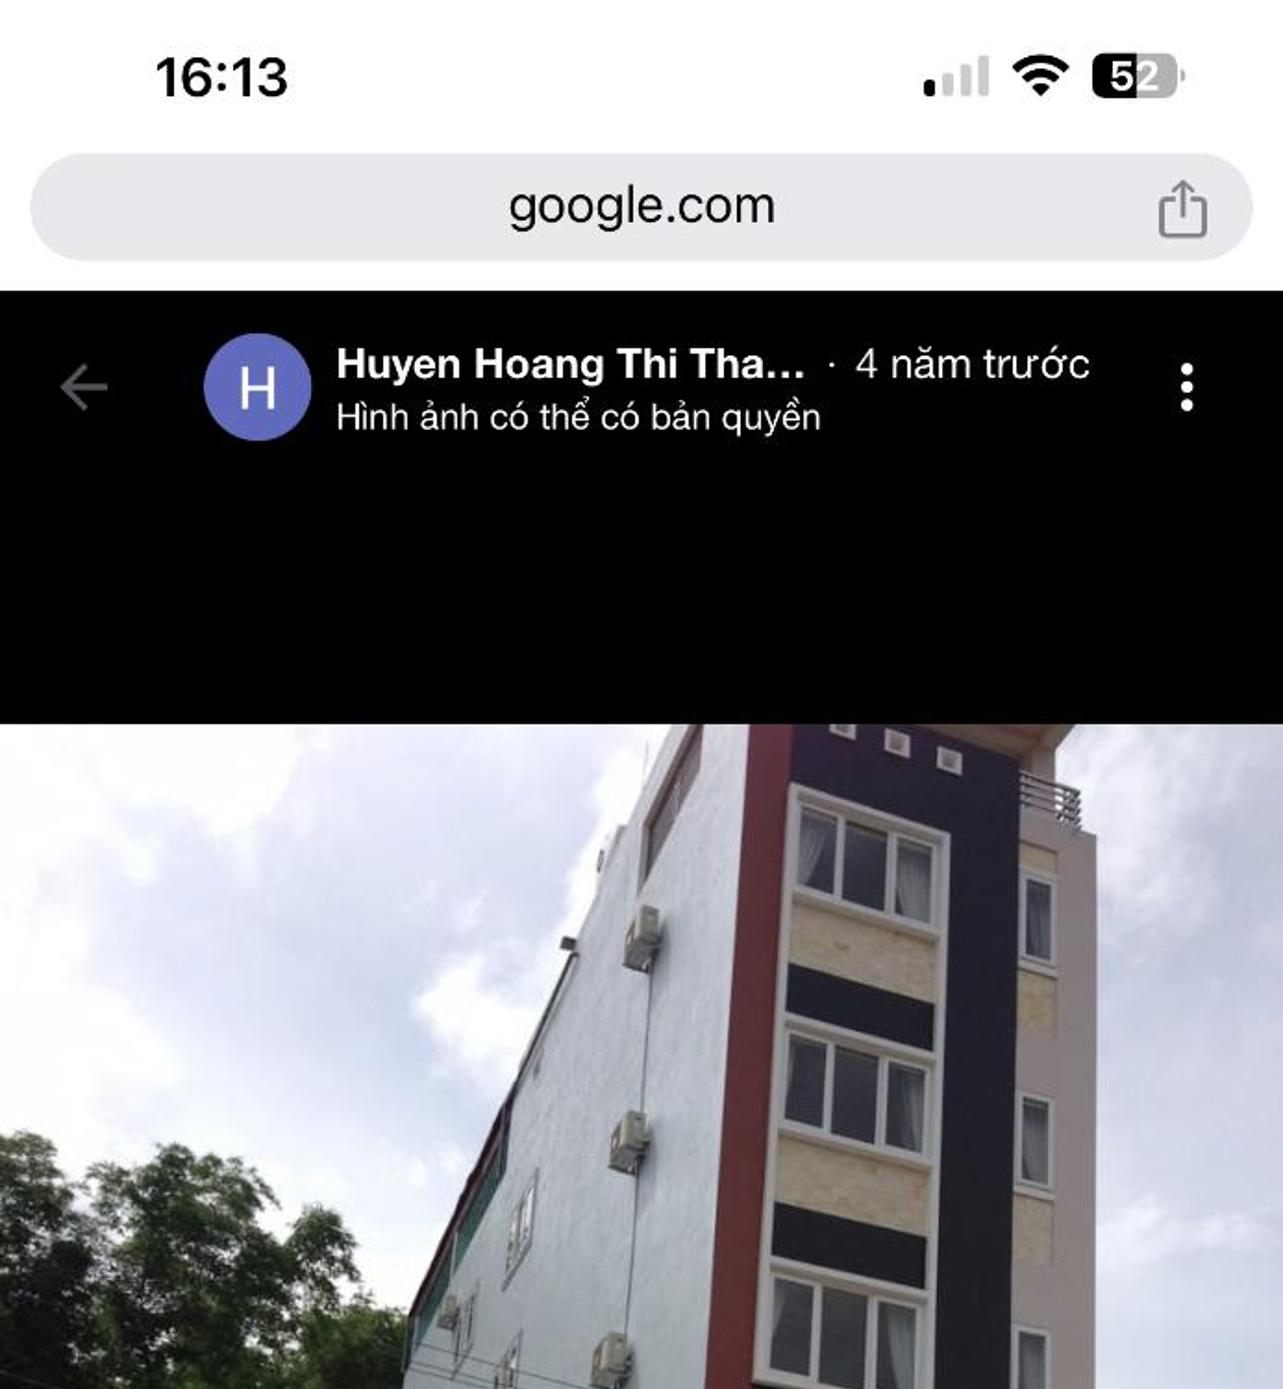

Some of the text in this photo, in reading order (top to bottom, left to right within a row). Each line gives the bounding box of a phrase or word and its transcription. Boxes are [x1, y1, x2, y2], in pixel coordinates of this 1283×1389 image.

[157, 57, 288, 98] 16:13
[1110, 60, 1159, 92] 52
[509, 183, 775, 233] google.com
[337, 347, 460, 387] Huyen
[475, 347, 604, 387] Hoang
[616, 347, 677, 379] Thi
[855, 344, 1090, 380] 4 năm trước
[241, 366, 275, 410] H
[337, 395, 821, 438] Hình ảnh có thể có bản quyền
